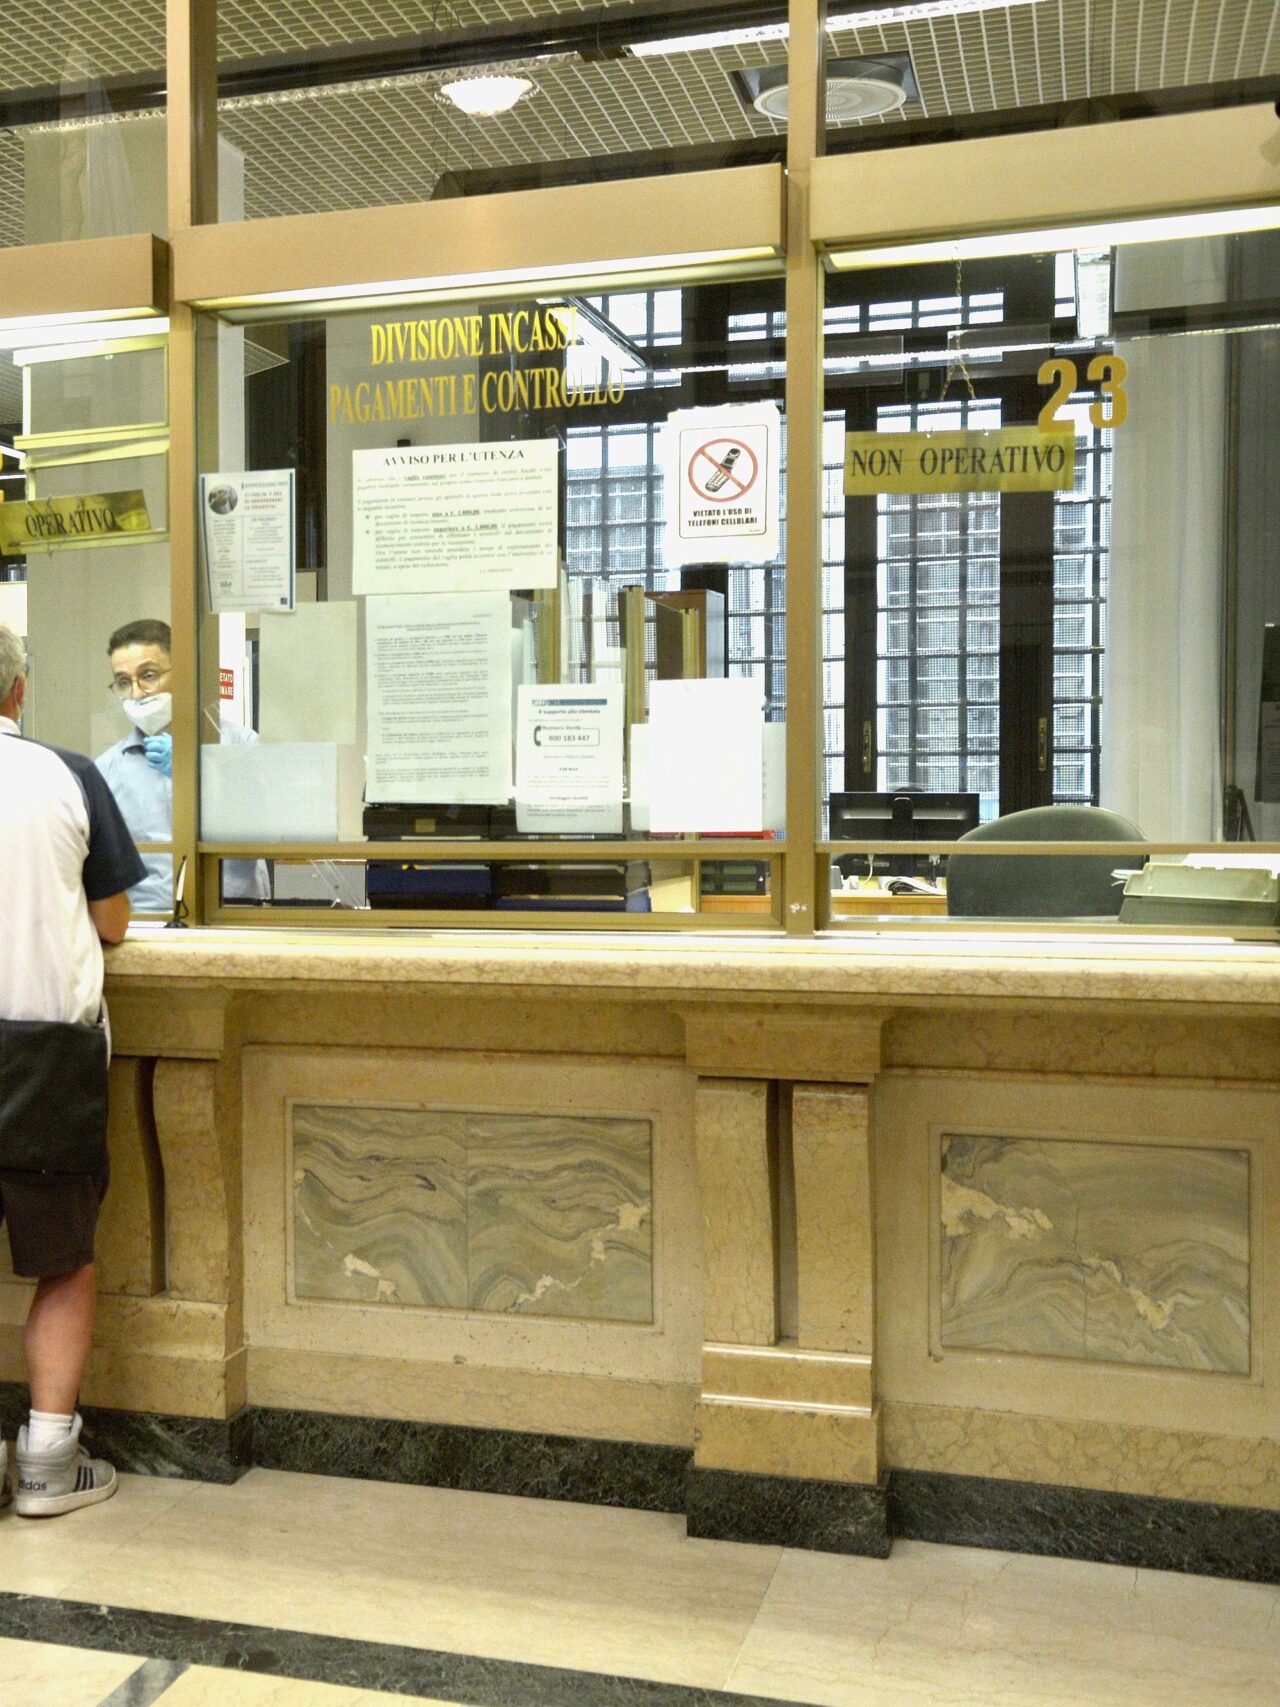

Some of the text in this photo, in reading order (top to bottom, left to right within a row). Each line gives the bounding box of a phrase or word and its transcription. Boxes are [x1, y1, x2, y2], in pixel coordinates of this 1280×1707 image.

[371, 307, 578, 366] DIVISIONE INCASSI
[329, 366, 625, 424] PAGAMENTI E CONTROLLO
[1037, 355, 1129, 434] 23
[383, 450, 525, 467] AVVISO PER L'UTENZA
[851, 444, 1066, 477] NON OPERATIVO
[24, 507, 119, 538] OPERATIVO
[688, 516, 757, 527] TELEFONI CELLULARI
[693, 509, 721, 518] VIETATO
[744, 508, 753, 516] DI
[18, 1479, 47, 1491] didas
